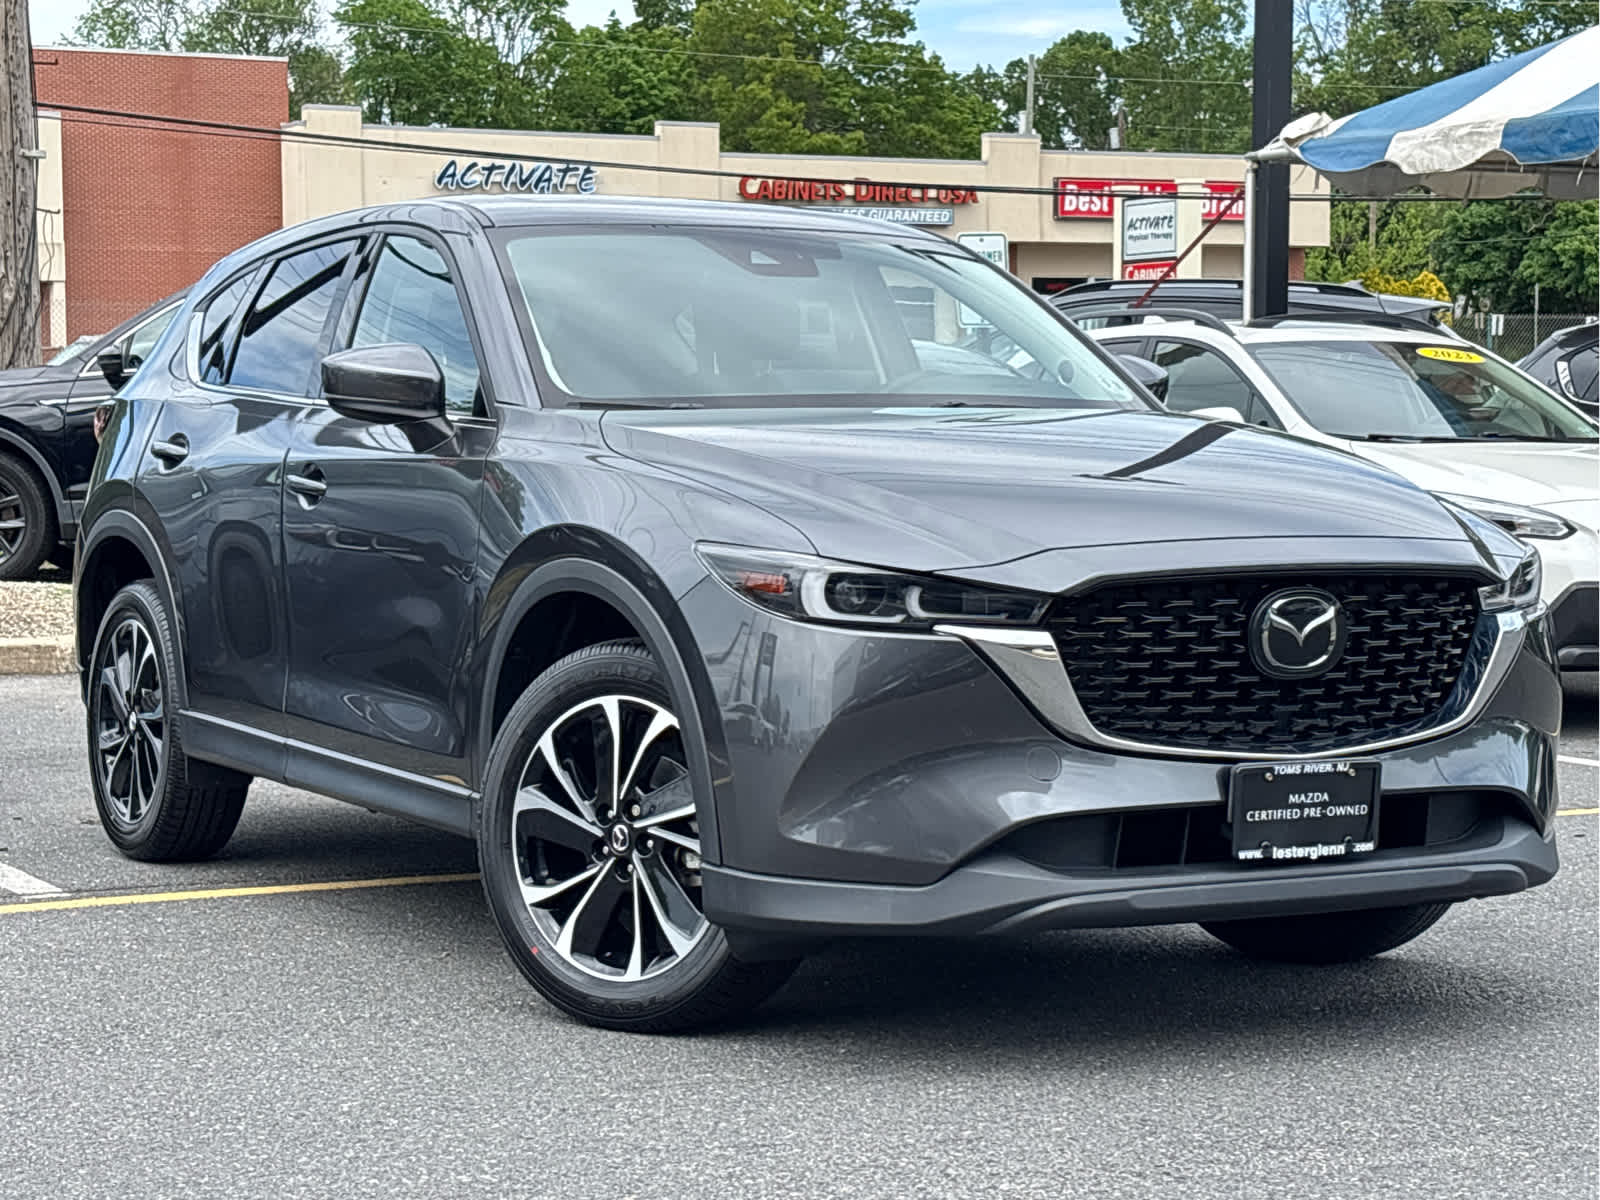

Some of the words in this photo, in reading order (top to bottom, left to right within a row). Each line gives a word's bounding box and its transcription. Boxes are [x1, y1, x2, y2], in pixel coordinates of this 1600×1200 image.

[435, 159, 598, 193] ACTIVATE
[739, 176, 846, 201] CABINETS
[938, 186, 979, 204] USA
[1063, 184, 1110, 212] Best
[868, 209, 950, 222] GUARANTEED
[1127, 215, 1174, 231] ACTIVATE
[1128, 233, 1149, 242] Physical
[1150, 232, 1173, 240] Therapy
[1432, 349, 1473, 361] 2023
[1273, 764, 1301, 775] TOMS
[1336, 762, 1350, 772] NJ
[1288, 792, 1329, 804] MAZDA
[1246, 809, 1300, 822] CERTIFIED
[1303, 804, 1368, 818] PRE-OWNED
